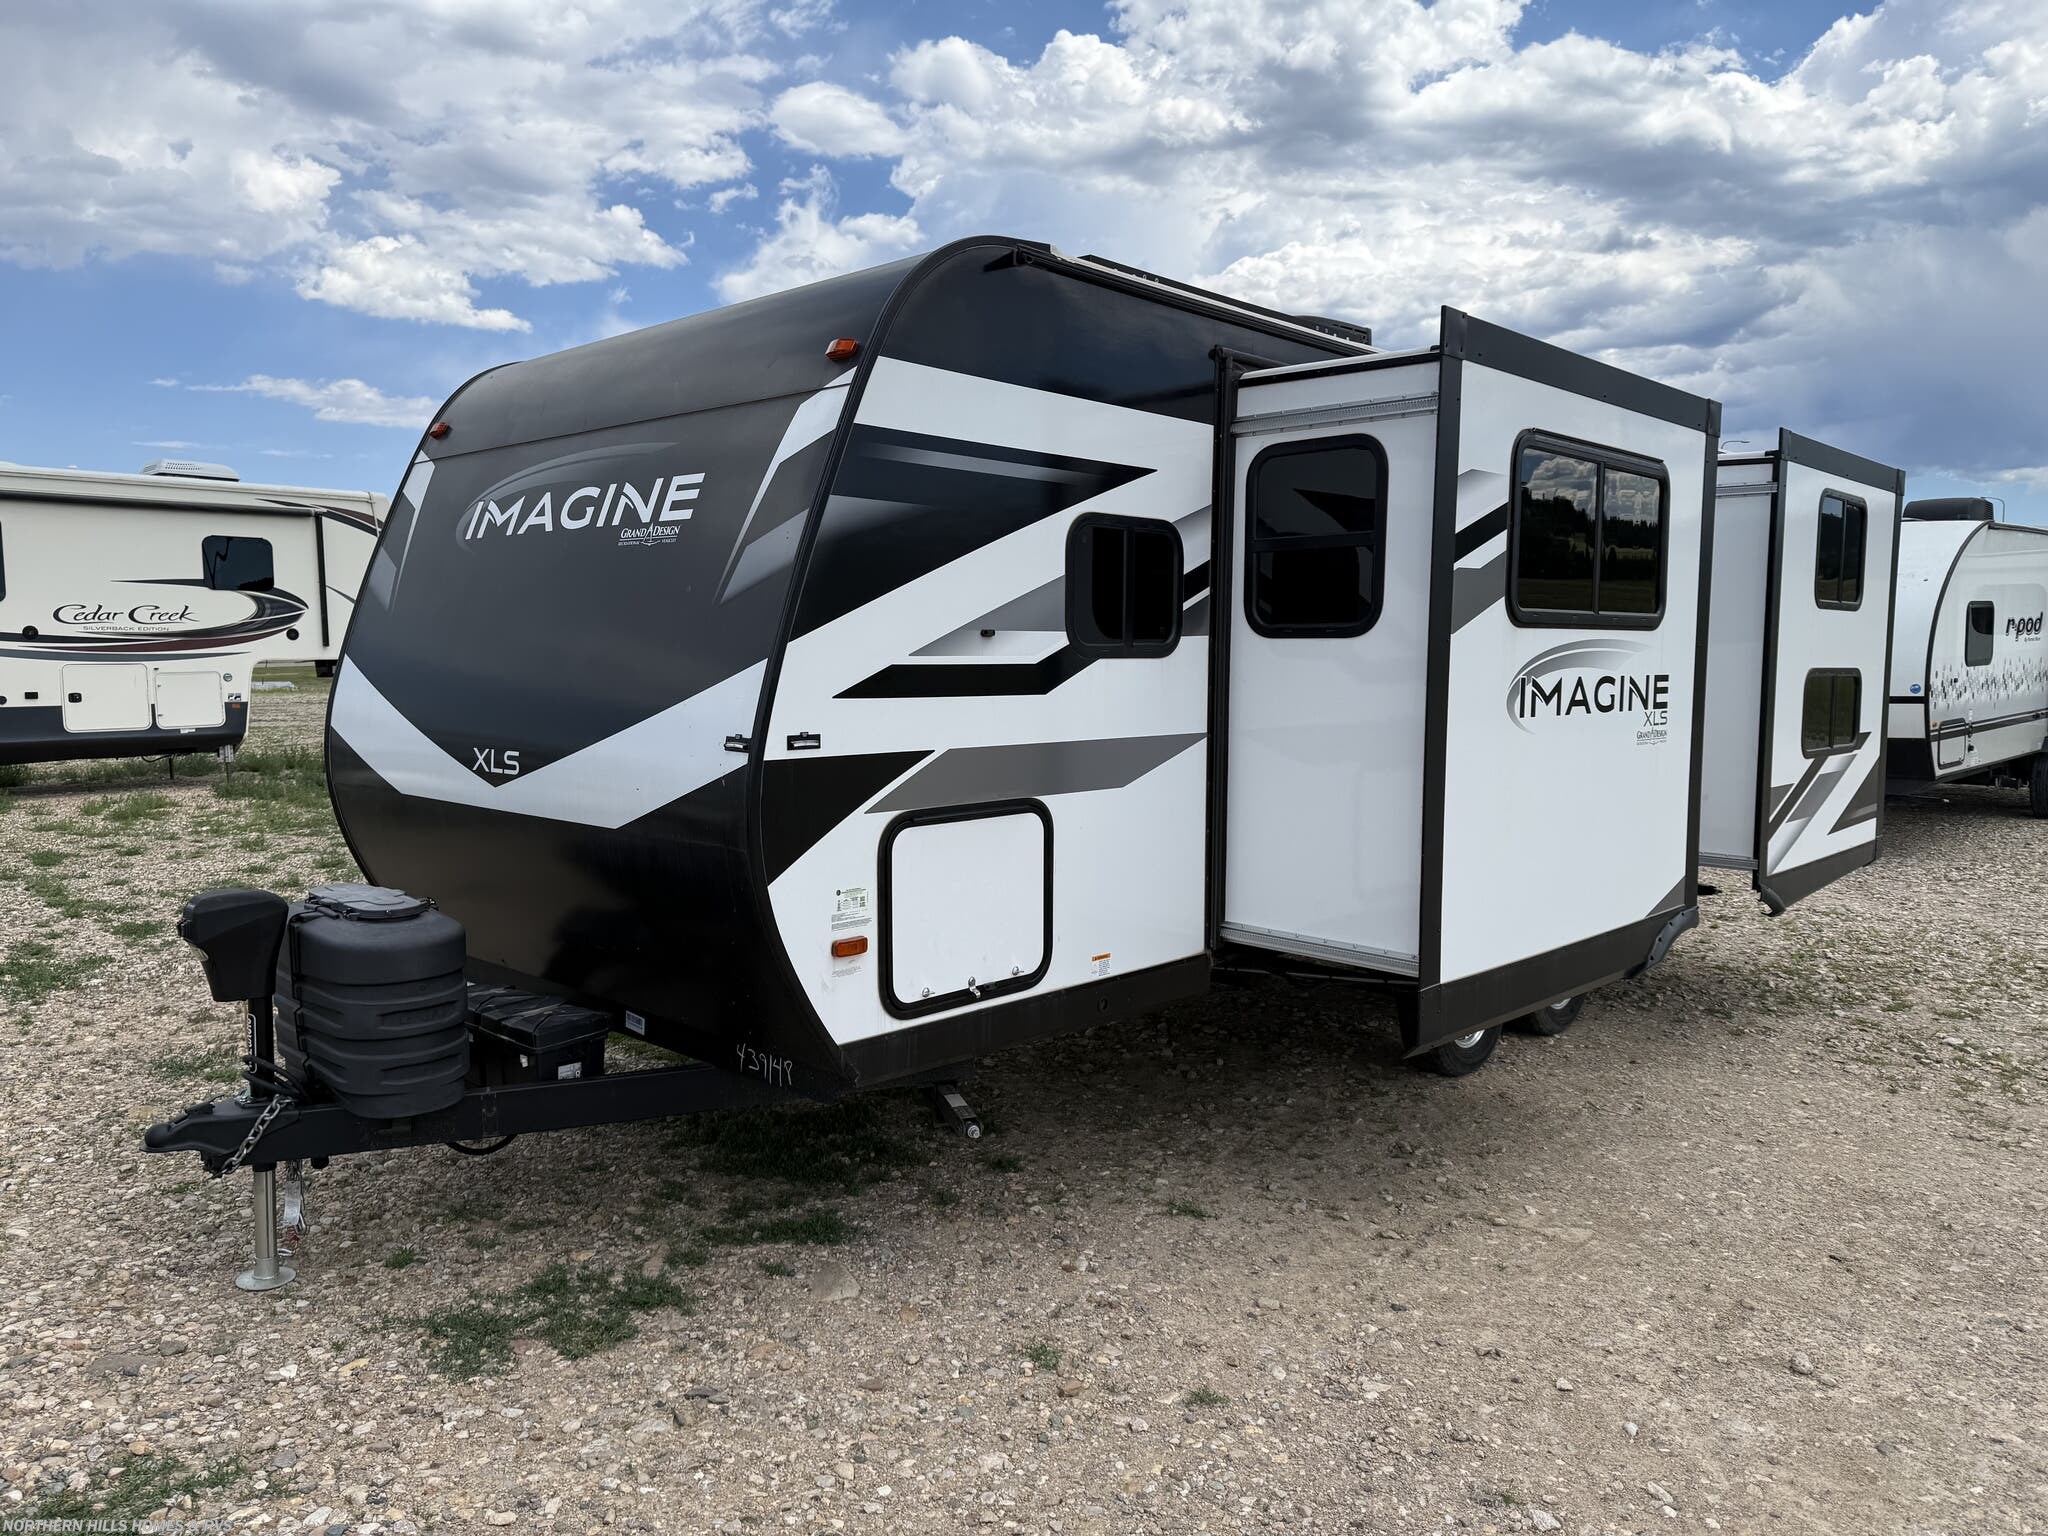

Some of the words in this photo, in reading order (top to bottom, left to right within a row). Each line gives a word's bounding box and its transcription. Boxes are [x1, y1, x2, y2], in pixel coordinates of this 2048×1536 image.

[465, 472, 706, 540] IMAGINE
[620, 527, 647, 538] GRAND
[653, 525, 681, 536] DESIGN
[53, 604, 125, 625] Cedar
[128, 604, 201, 625] Creek
[1519, 674, 1670, 719] IMAGINE
[1643, 710, 1668, 727] XLS
[472, 747, 520, 776] XLS
